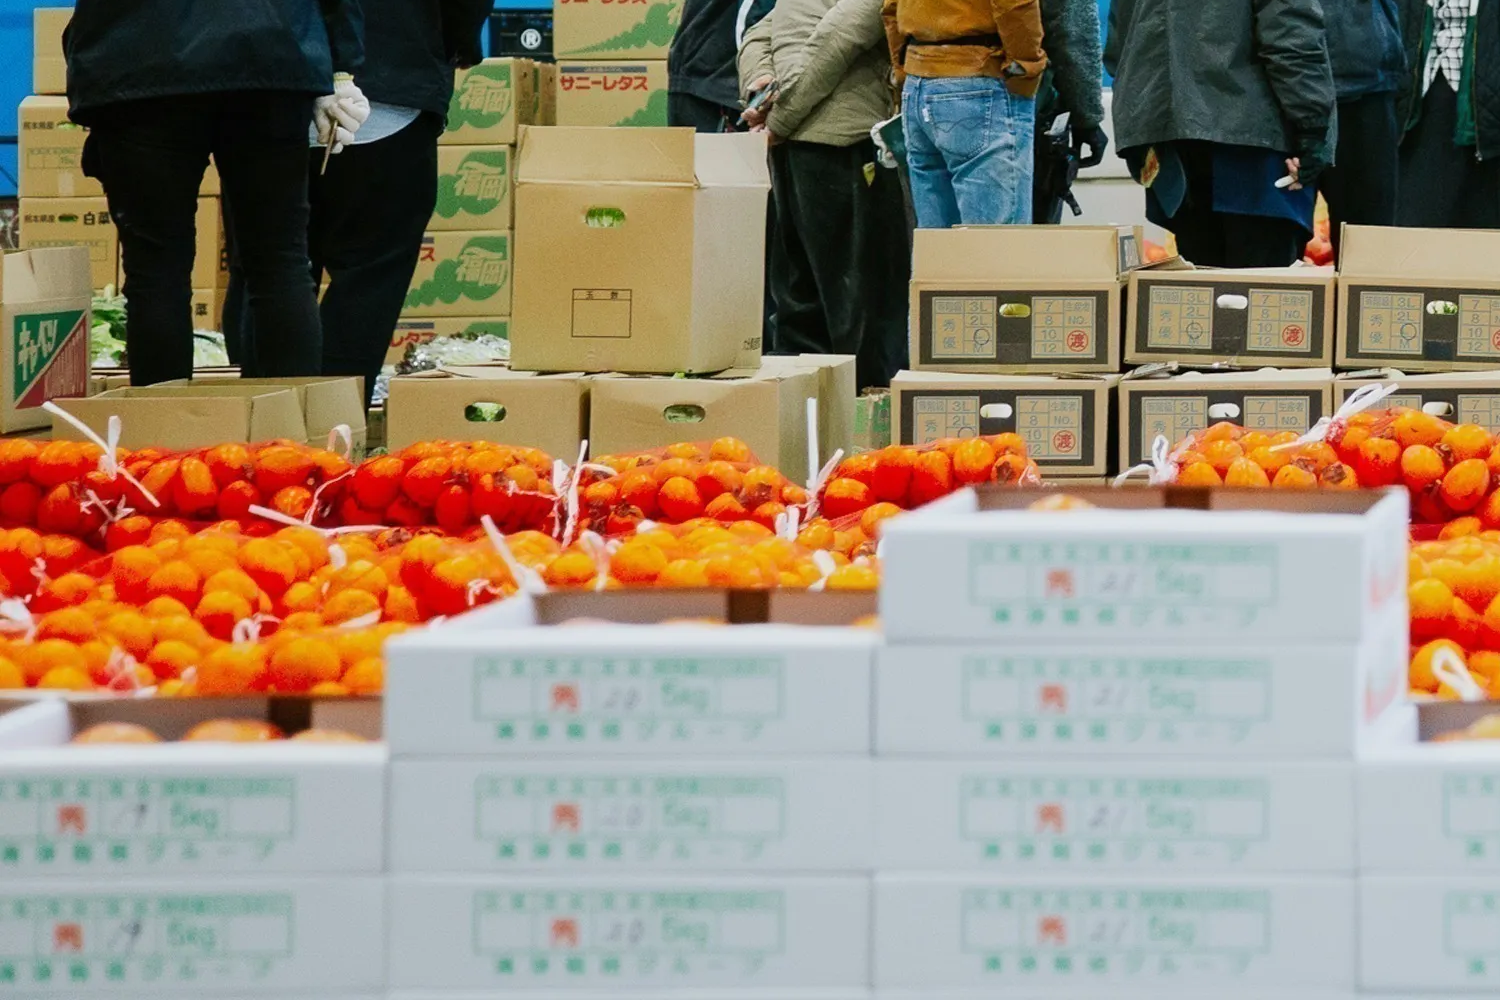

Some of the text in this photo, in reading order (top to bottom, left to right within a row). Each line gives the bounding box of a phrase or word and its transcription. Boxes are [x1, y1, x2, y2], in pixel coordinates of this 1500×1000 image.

[560, 76, 648, 91] サニーレタス
[1187, 292, 1205, 303] 3L
[1398, 297, 1415, 308] 3L
[969, 302, 988, 312] 3L
[1186, 307, 1205, 317] 2L
[970, 315, 988, 326] 2L
[1397, 312, 1414, 322] 2L
[1257, 323, 1272, 333] 10
[1468, 328, 1483, 338] 10
[1041, 329, 1056, 339] 10
[1257, 337, 1271, 346] 12
[1467, 341, 1481, 351] 12
[1041, 343, 1056, 353] 12
[952, 401, 970, 412] 3L
[1180, 402, 1197, 413] 3L
[952, 415, 971, 426] 2L
[1180, 416, 1198, 426] 2L
[1025, 429, 1042, 440] 10
